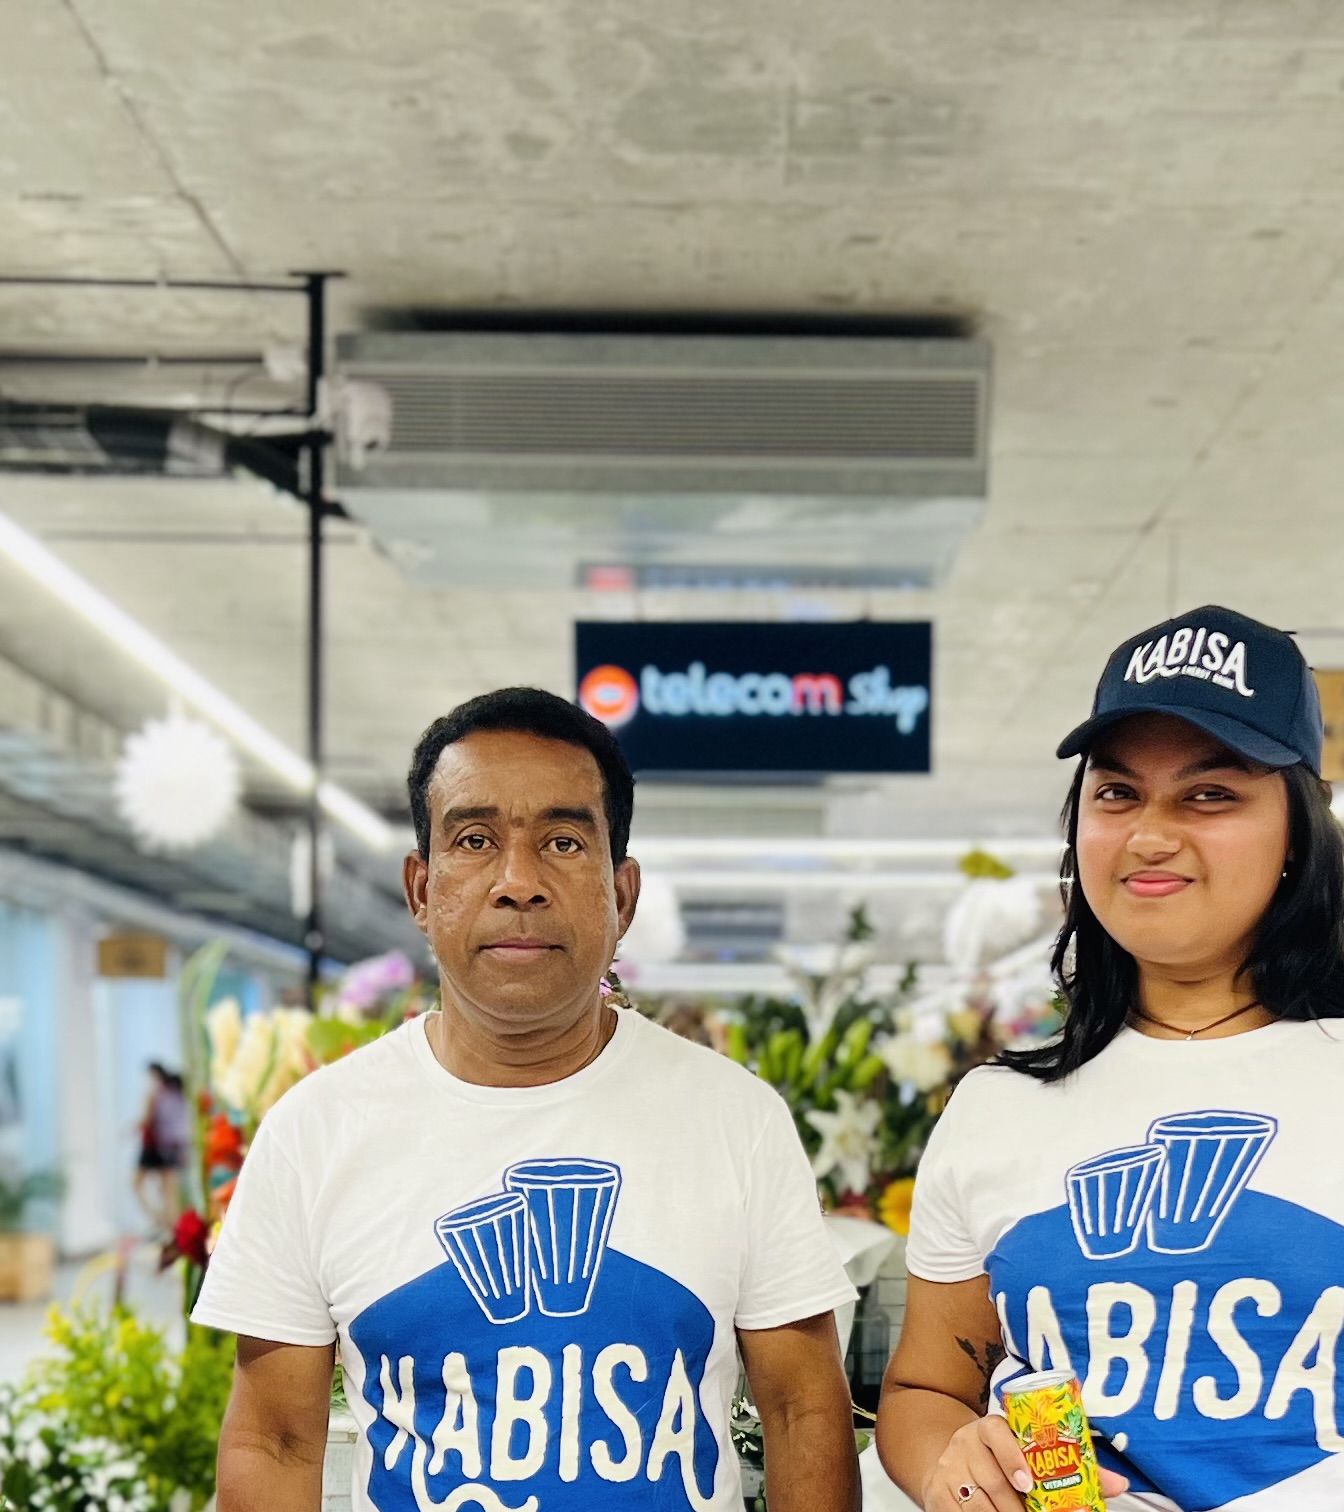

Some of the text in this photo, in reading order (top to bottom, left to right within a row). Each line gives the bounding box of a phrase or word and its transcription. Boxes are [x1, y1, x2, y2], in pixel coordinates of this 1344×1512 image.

[640, 661, 843, 716] telecom
[1124, 627, 1255, 697] KABISA
[1025, 1444, 1083, 1478] KABISA
